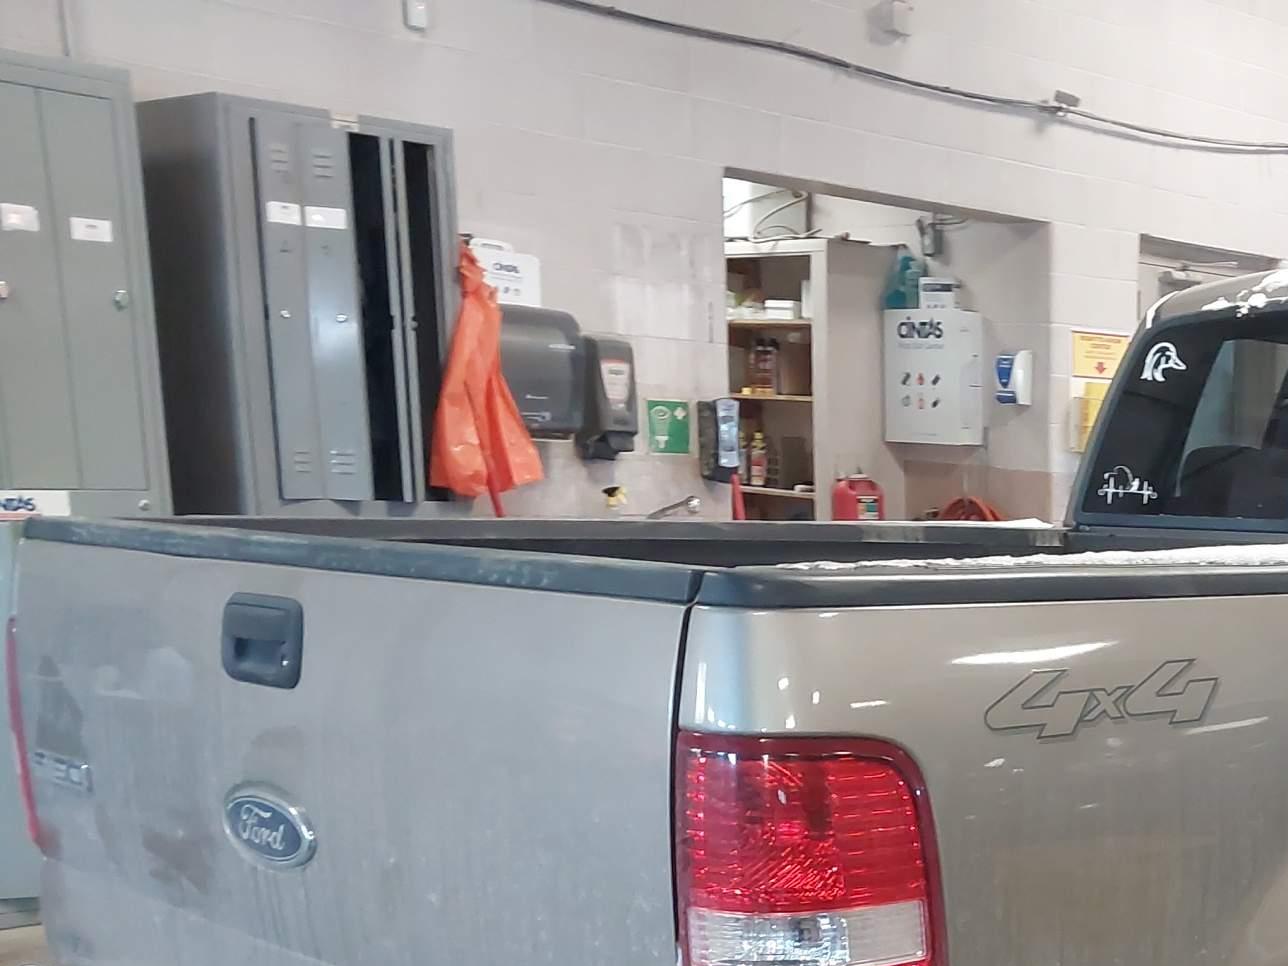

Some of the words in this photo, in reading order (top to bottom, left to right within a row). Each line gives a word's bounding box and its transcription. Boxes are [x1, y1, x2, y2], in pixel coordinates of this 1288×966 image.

[896, 316, 944, 339] CINTAS
[984, 657, 1219, 740] 4x4
[239, 803, 286, 851] Ford
